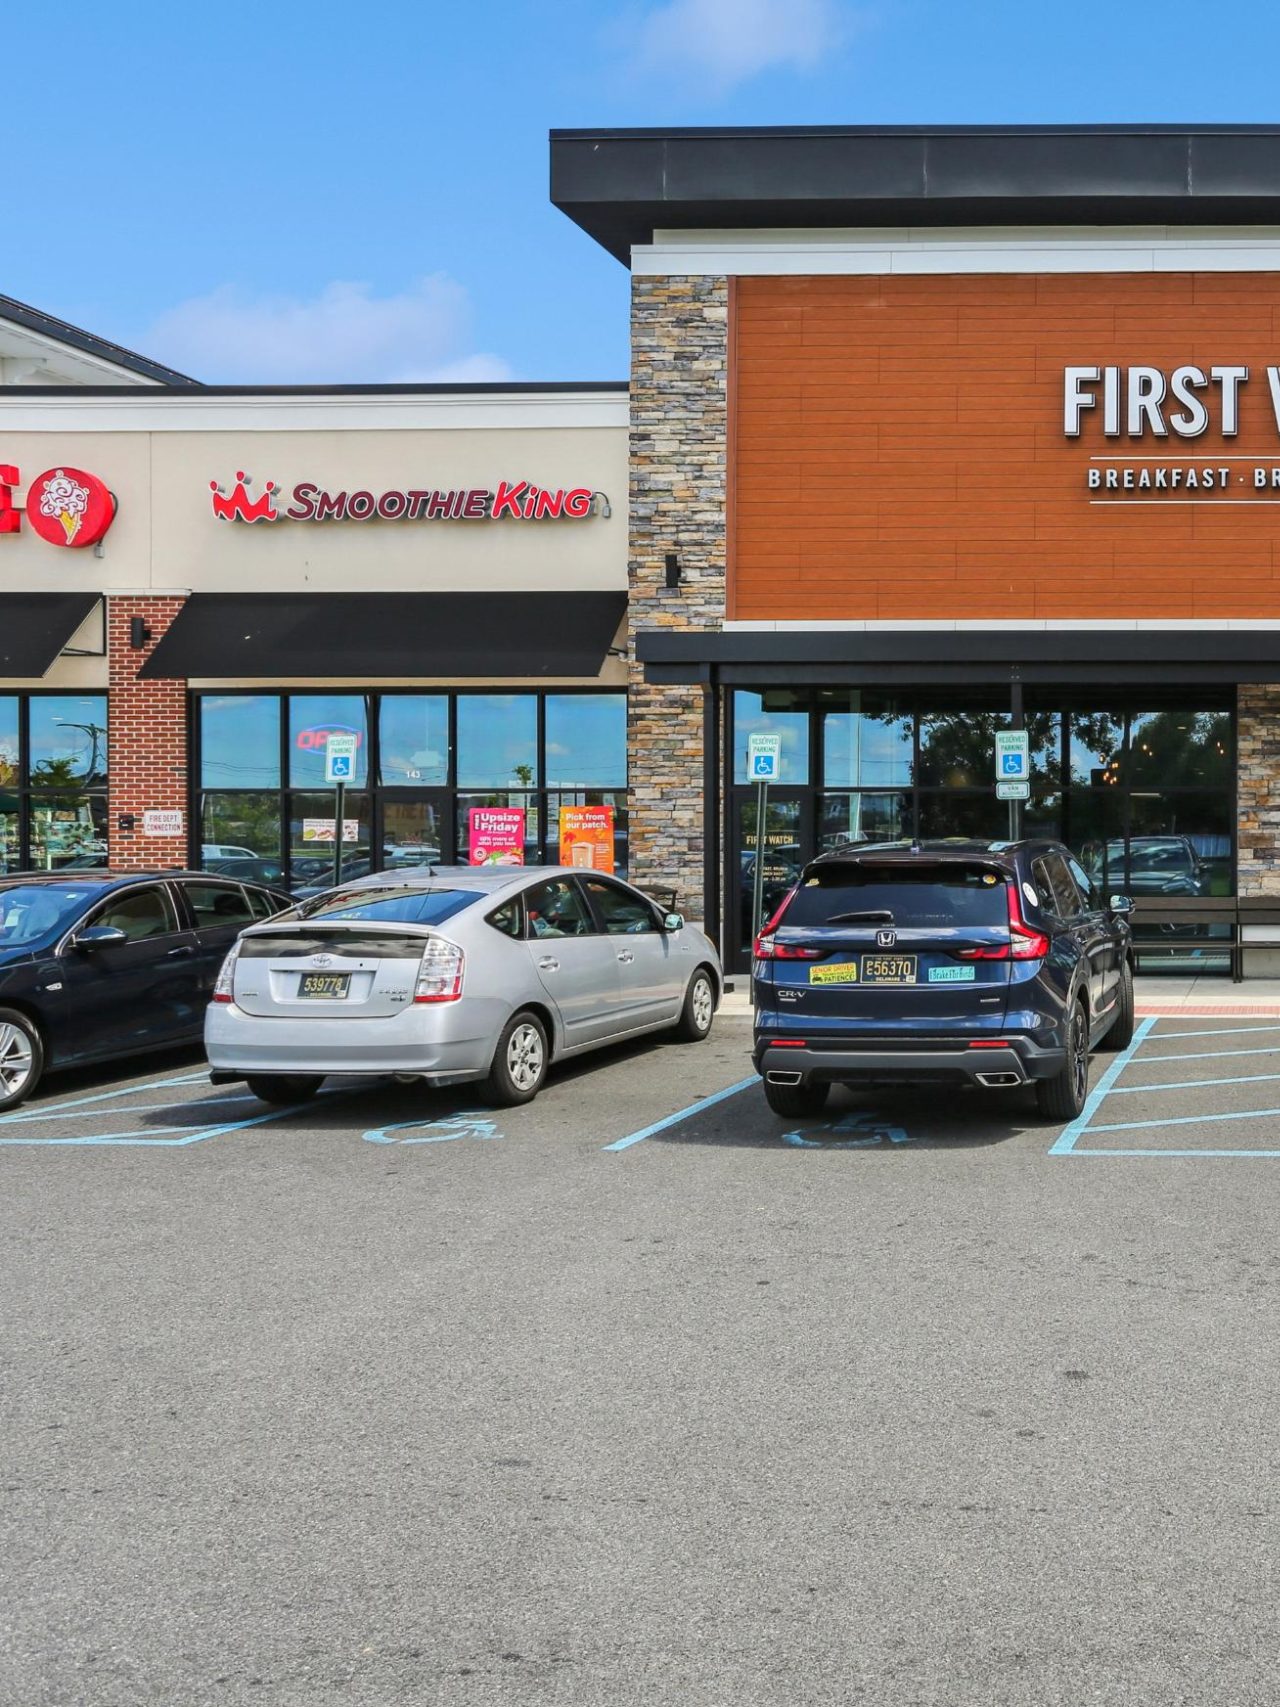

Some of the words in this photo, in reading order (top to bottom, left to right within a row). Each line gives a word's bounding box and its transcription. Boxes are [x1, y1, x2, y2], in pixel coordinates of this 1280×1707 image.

[1064, 365, 1249, 436] FIRST
[1087, 467, 1230, 488] BREAKFAST
[286, 482, 489, 521] SMOOTHIE
[406, 770, 421, 778] 143
[149, 814, 162, 823] FIRE
[162, 814, 178, 823] DEPT
[480, 813, 521, 823] Upsize
[565, 813, 584, 821] Pick
[585, 813, 606, 821] from
[146, 824, 181, 832] CONNECTION
[480, 822, 519, 833] Friday
[581, 822, 609, 831] patch.
[768, 835, 794, 845] WATCH
[874, 960, 912, 976] 56370
[303, 977, 343, 991] 539778
